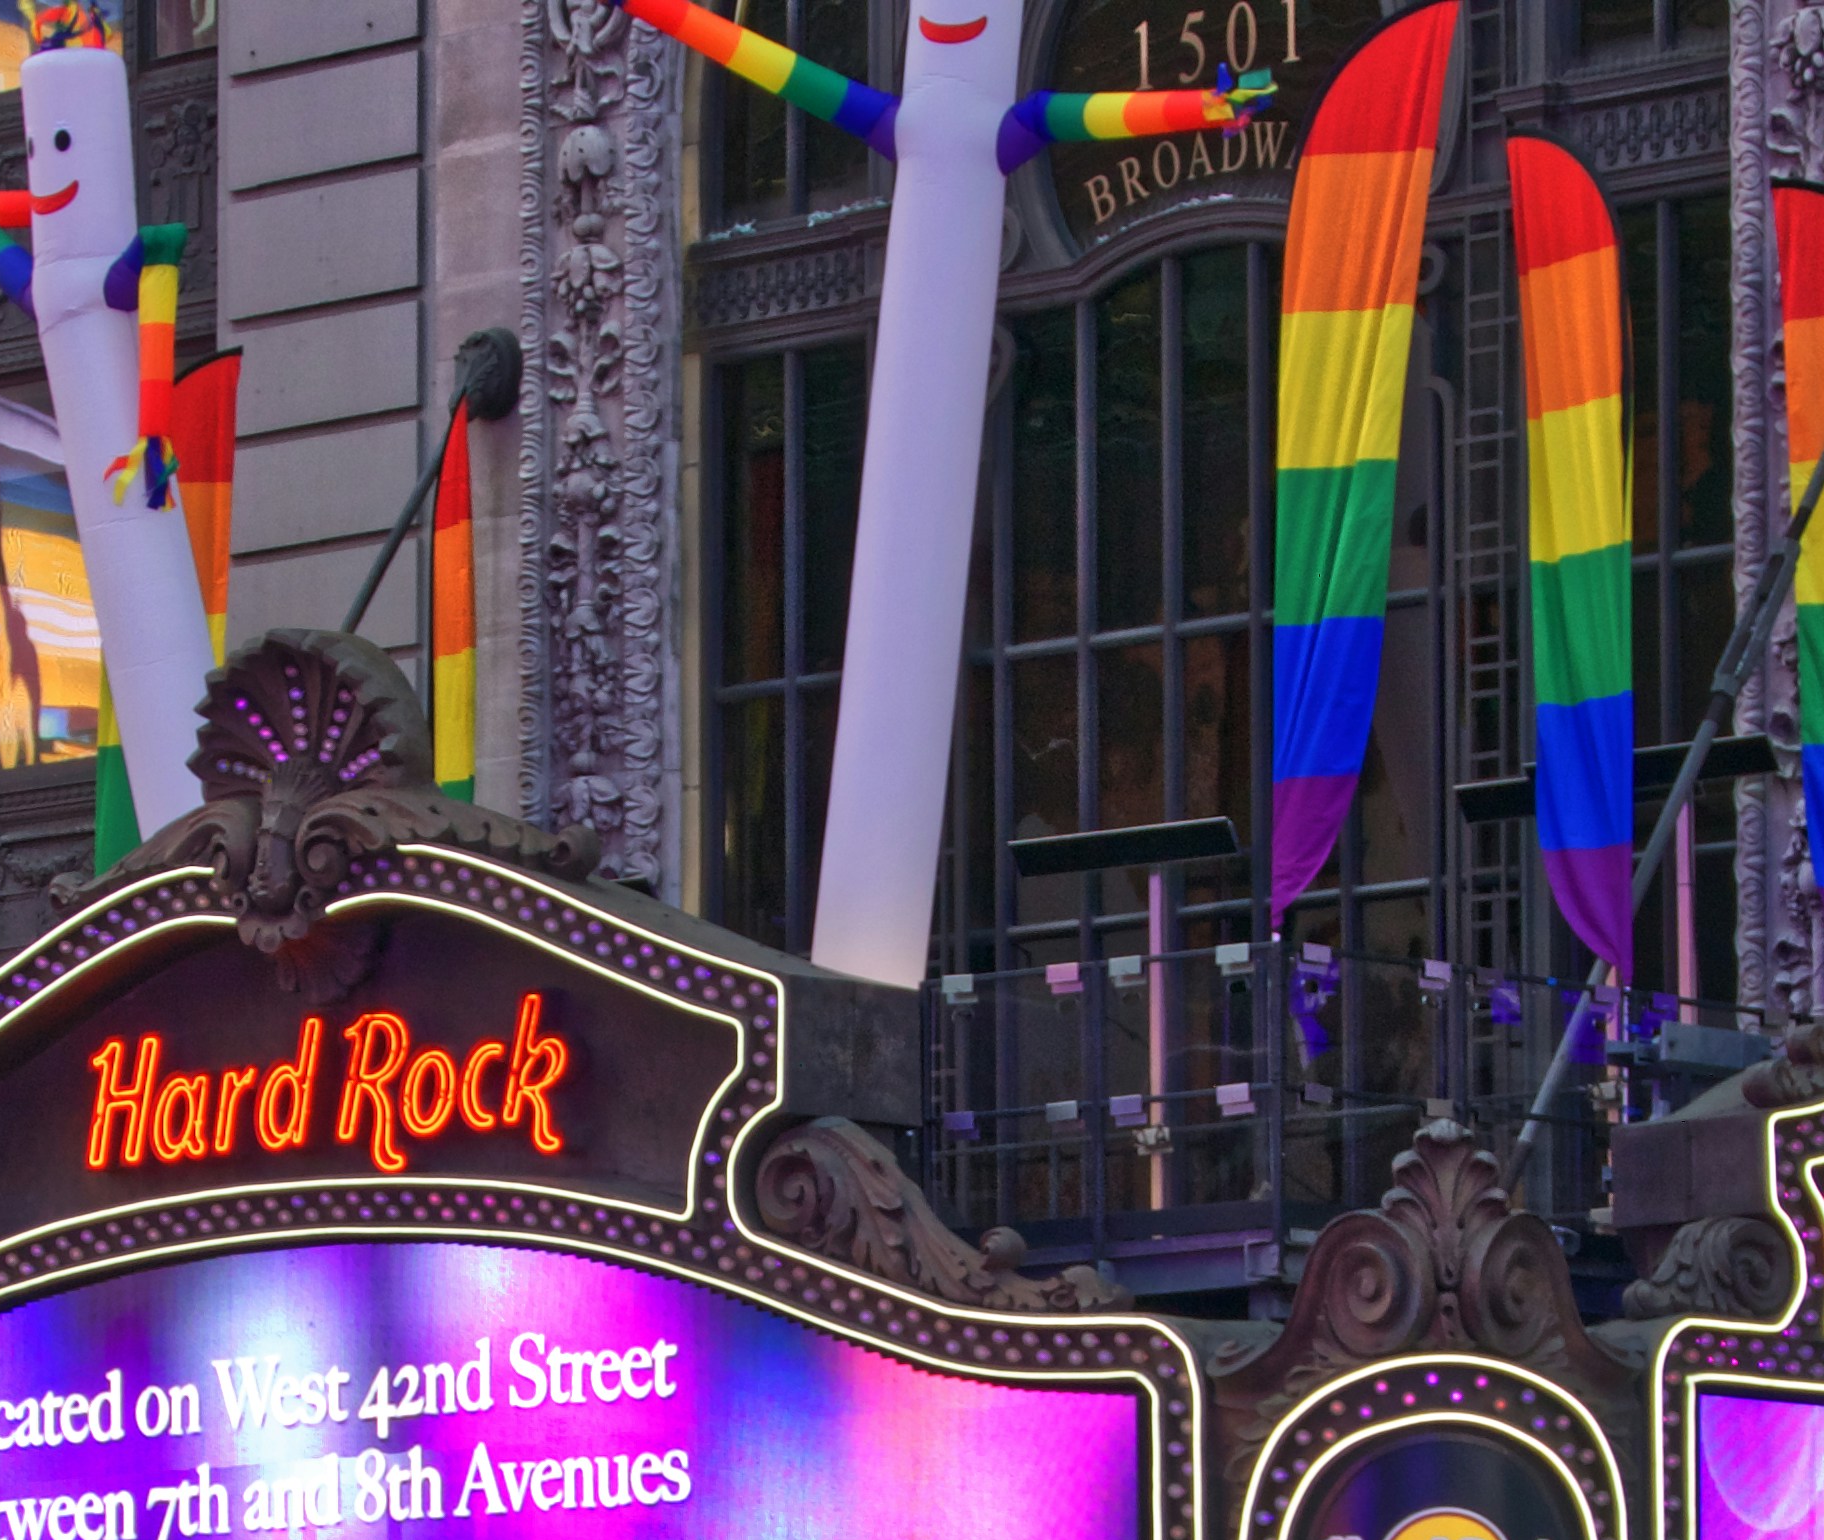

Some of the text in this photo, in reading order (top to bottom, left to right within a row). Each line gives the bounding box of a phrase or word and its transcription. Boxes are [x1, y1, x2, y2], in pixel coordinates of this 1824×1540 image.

[1084, 120, 1296, 224] BROADW
[88, 994, 568, 1171] Hard Rock
[135, 1382, 202, 1438] on
[211, 1355, 350, 1430] West
[358, 1337, 494, 1439] 42nd
[509, 1332, 677, 1408] Street
[242, 1452, 343, 1530] and
[354, 1444, 444, 1523] 8th
[453, 1442, 691, 1518] Avenues
